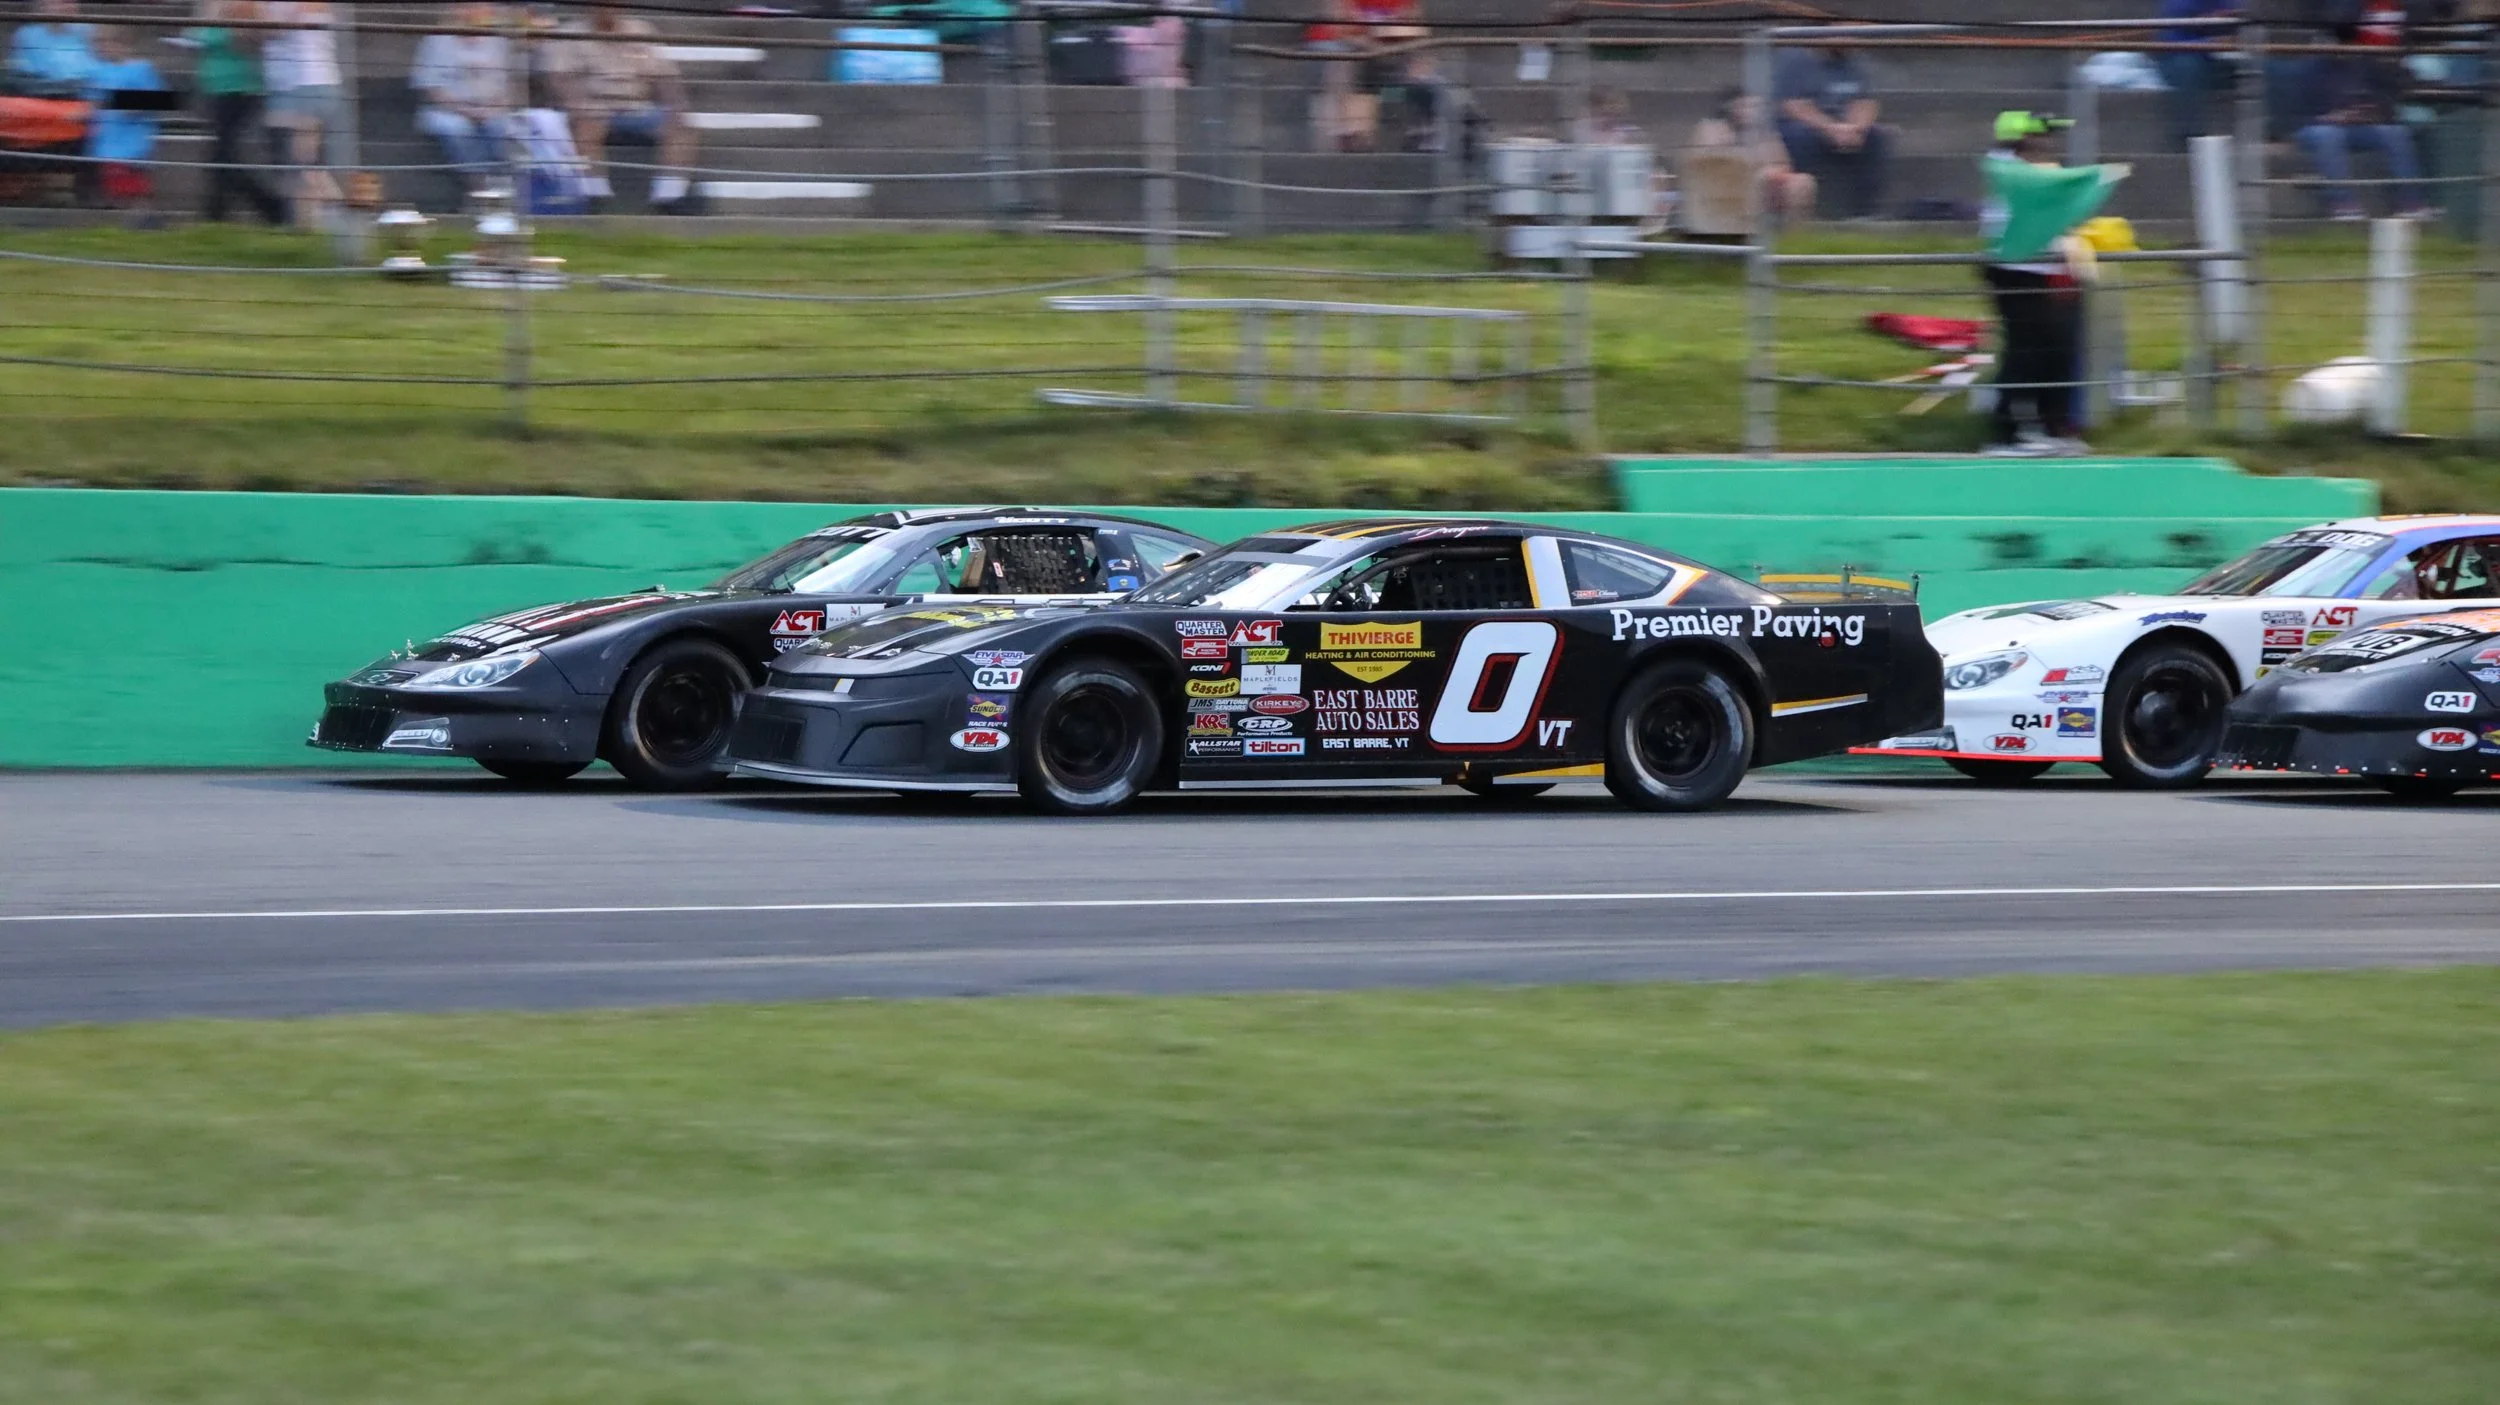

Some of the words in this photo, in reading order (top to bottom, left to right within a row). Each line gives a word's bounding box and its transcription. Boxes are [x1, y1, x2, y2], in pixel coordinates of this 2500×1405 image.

[771, 610, 824, 632] ACT
[2312, 607, 2359, 626] ACT
[1177, 621, 1221, 631] QUARTER
[1185, 628, 1226, 636] MASTER
[1229, 620, 1284, 644] ACT
[1610, 607, 1743, 641] Premier
[1750, 605, 1866, 646] Paving
[1328, 631, 1415, 645] THIVIERGE
[1267, 649, 1286, 657] ROAD
[1305, 651, 1344, 660] HEATING
[1346, 651, 1352, 659] &
[1355, 650, 1370, 659] AIR
[1371, 650, 1436, 659] CONDITIONING
[977, 671, 1018, 686] QA1
[1429, 620, 1562, 747] 0
[1191, 681, 1236, 695] Bassett
[1190, 699, 1214, 708] JMS
[1256, 700, 1297, 708] KIRKEY
[1313, 690, 1359, 709] EAST
[1363, 689, 1419, 709] BARRE
[2430, 695, 2471, 708] QA1
[971, 705, 1005, 713] SUNOCO
[1196, 714, 1228, 729] KRC
[1316, 711, 1362, 730] AUTO
[1366, 711, 1420, 730] SALES
[2011, 714, 2053, 730] QA1
[963, 732, 999, 747] VDL
[1538, 720, 1572, 748] VT
[1249, 741, 1300, 753] tilton
[1323, 738, 1350, 749] EAST
[1353, 738, 1392, 749] BARRE,
[1395, 738, 1410, 748] VT
